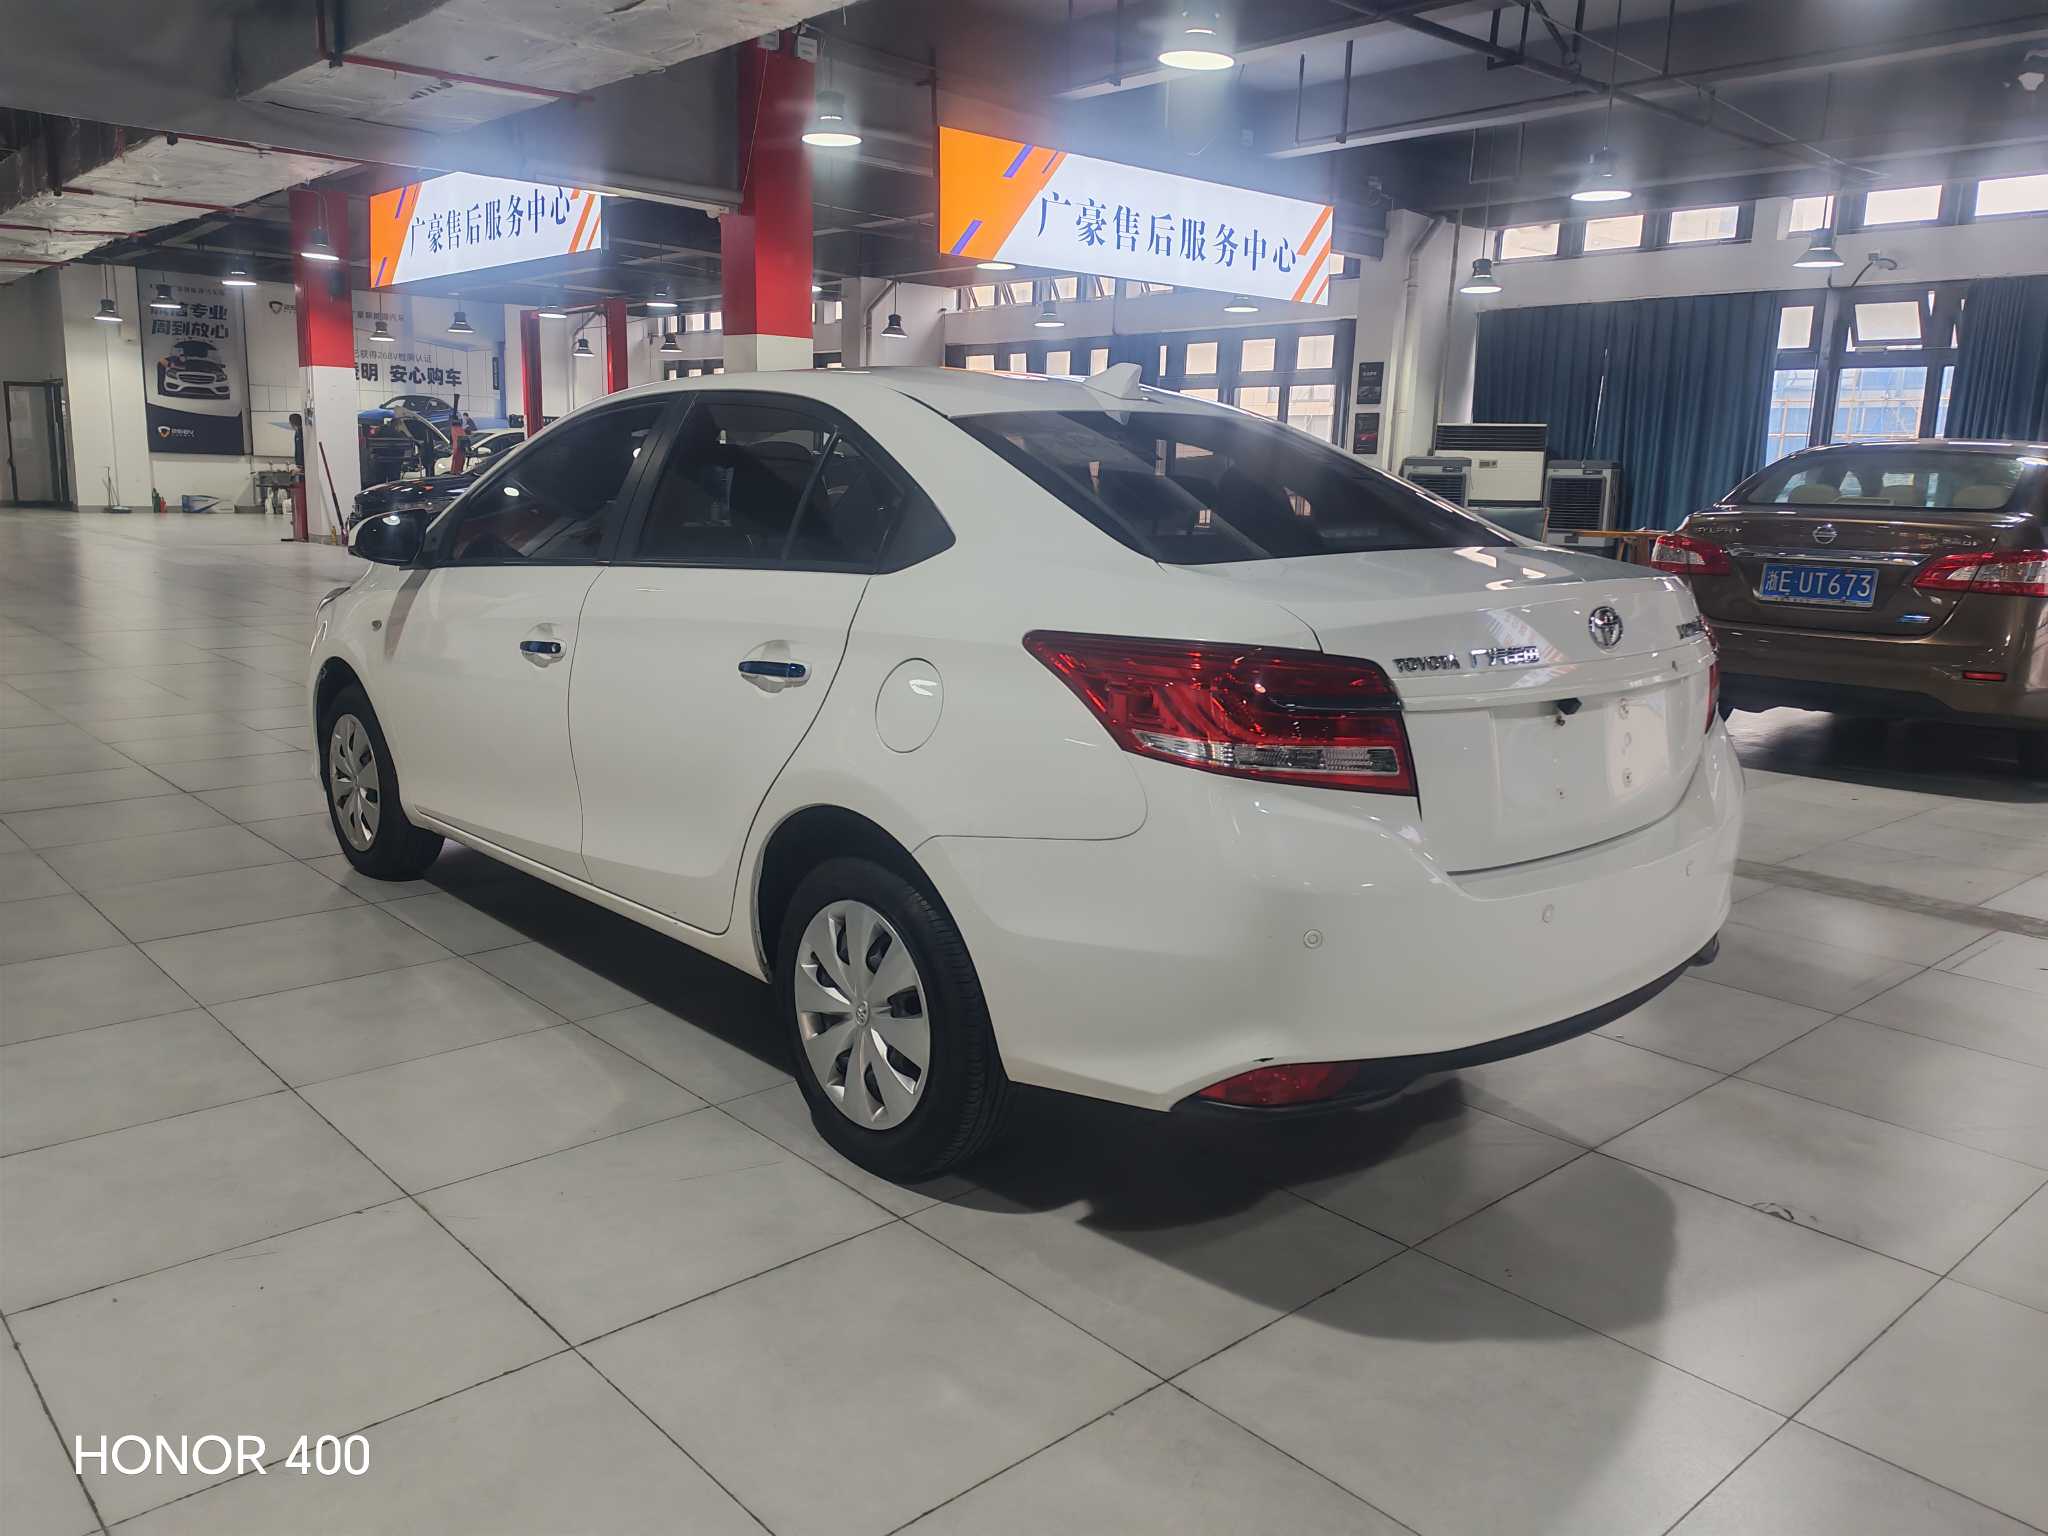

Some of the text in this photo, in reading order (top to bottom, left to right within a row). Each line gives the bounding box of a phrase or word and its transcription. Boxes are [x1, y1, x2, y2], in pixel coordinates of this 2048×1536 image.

[410, 186, 570, 257] 广豪售后服务中心
[1037, 191, 1297, 273] 广豪售后服务中心
[151, 319, 229, 339] 周到放心
[389, 364, 463, 387] 安心购车
[1393, 654, 1461, 674] TOYOTA
